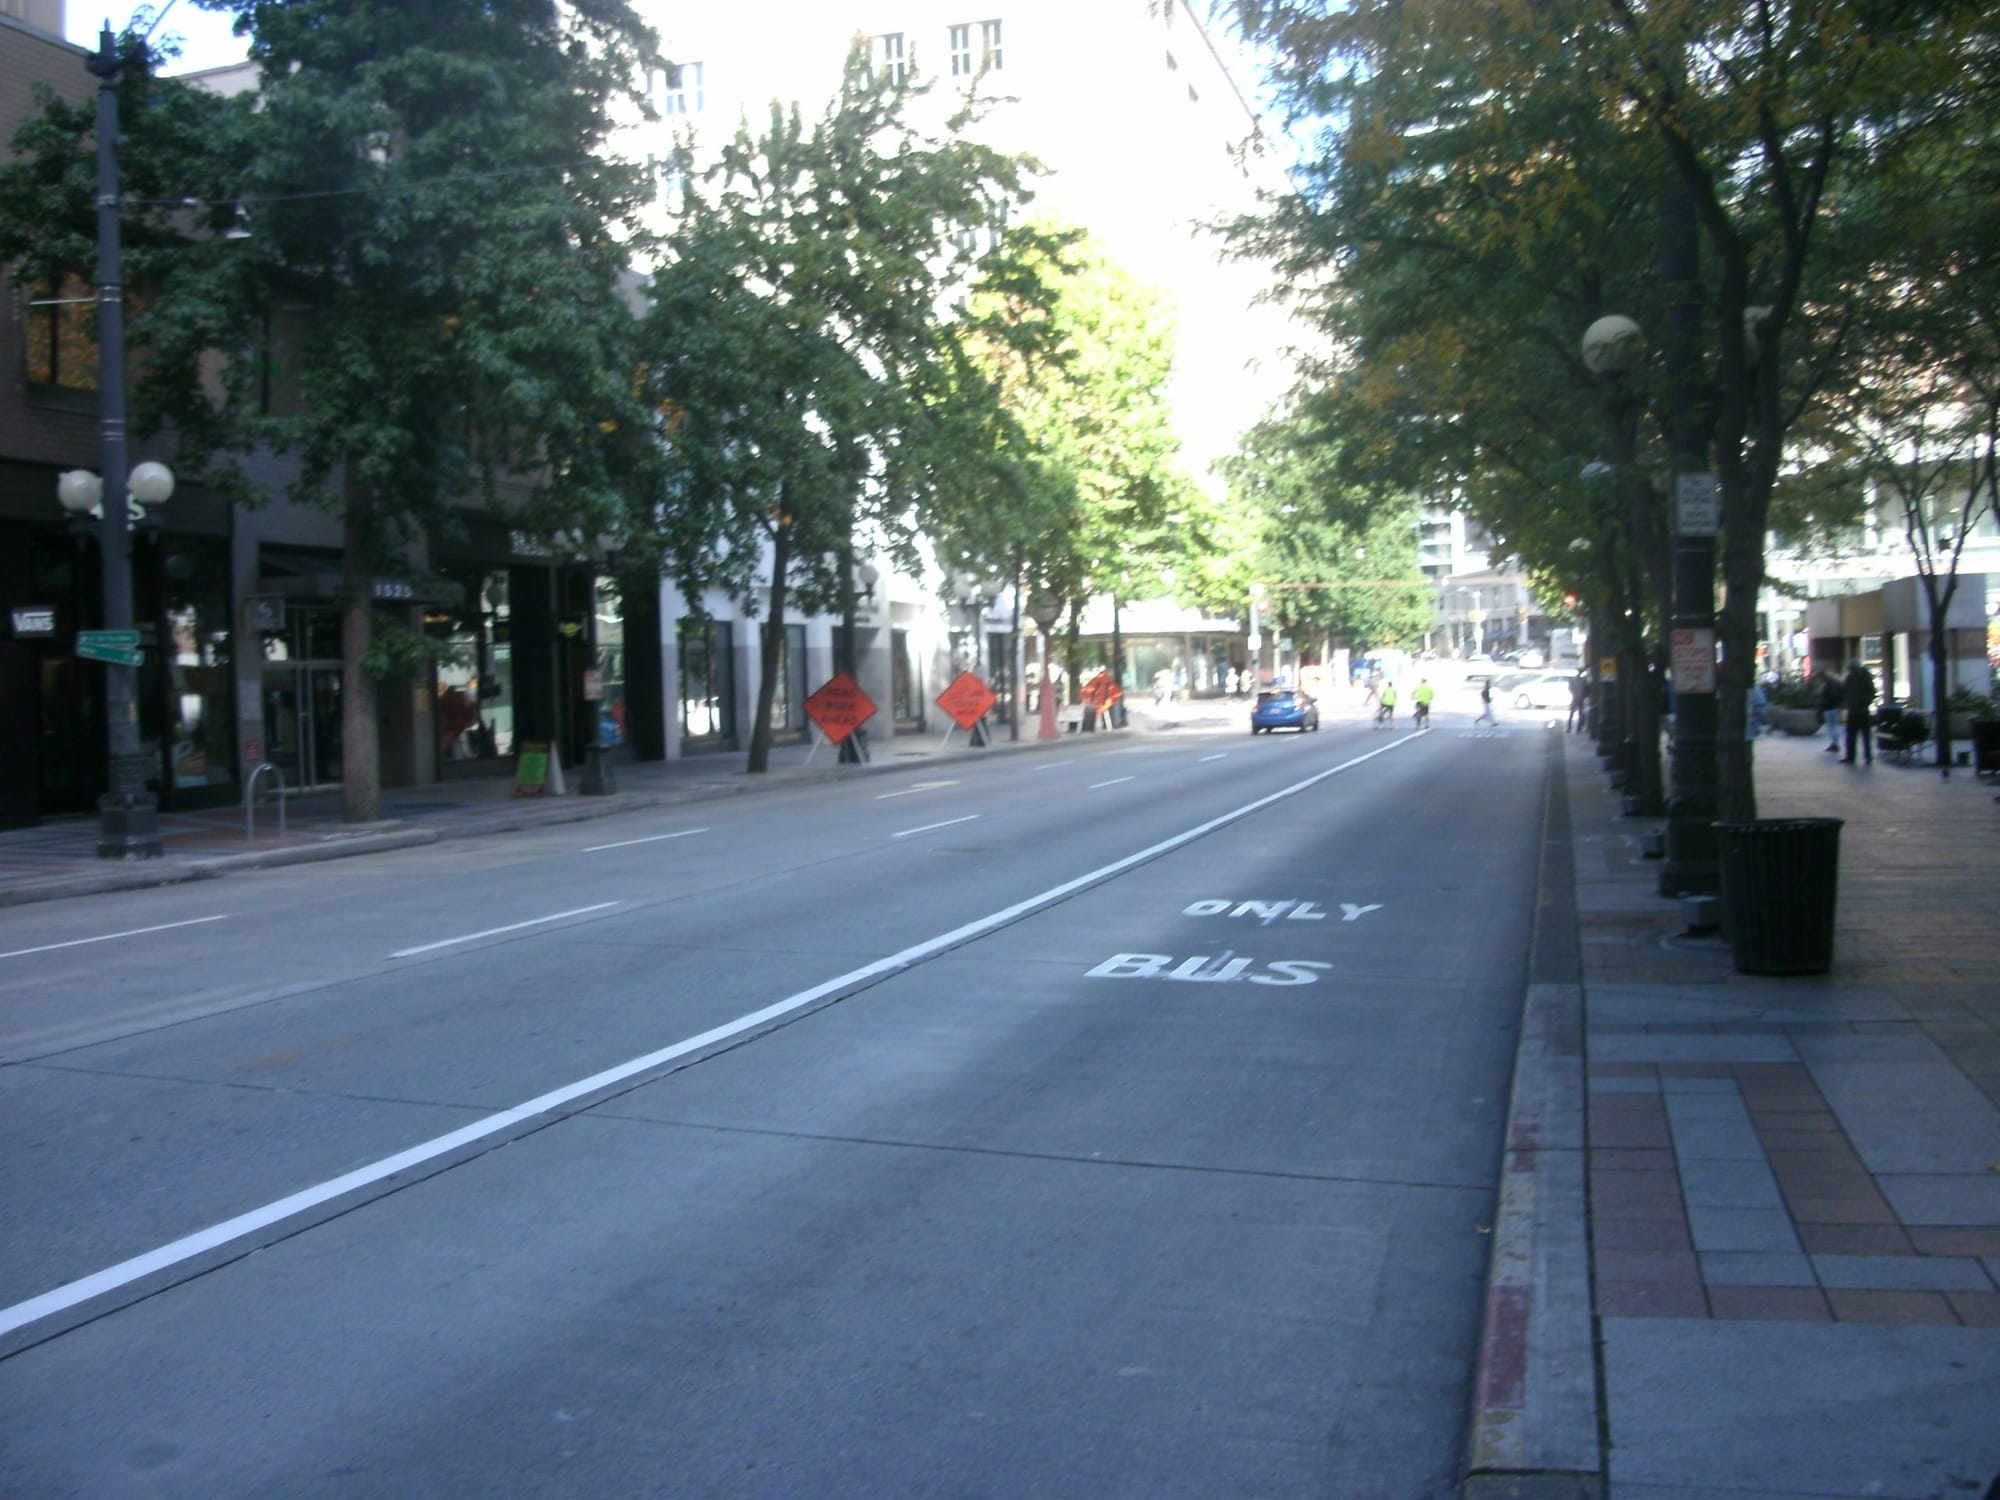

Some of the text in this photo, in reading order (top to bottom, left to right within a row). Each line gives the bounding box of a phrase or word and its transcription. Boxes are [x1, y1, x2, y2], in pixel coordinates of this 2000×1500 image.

[12, 611, 54, 632] VANS
[1181, 898, 1384, 926] ONLY
[1083, 951, 1333, 986] BUS
